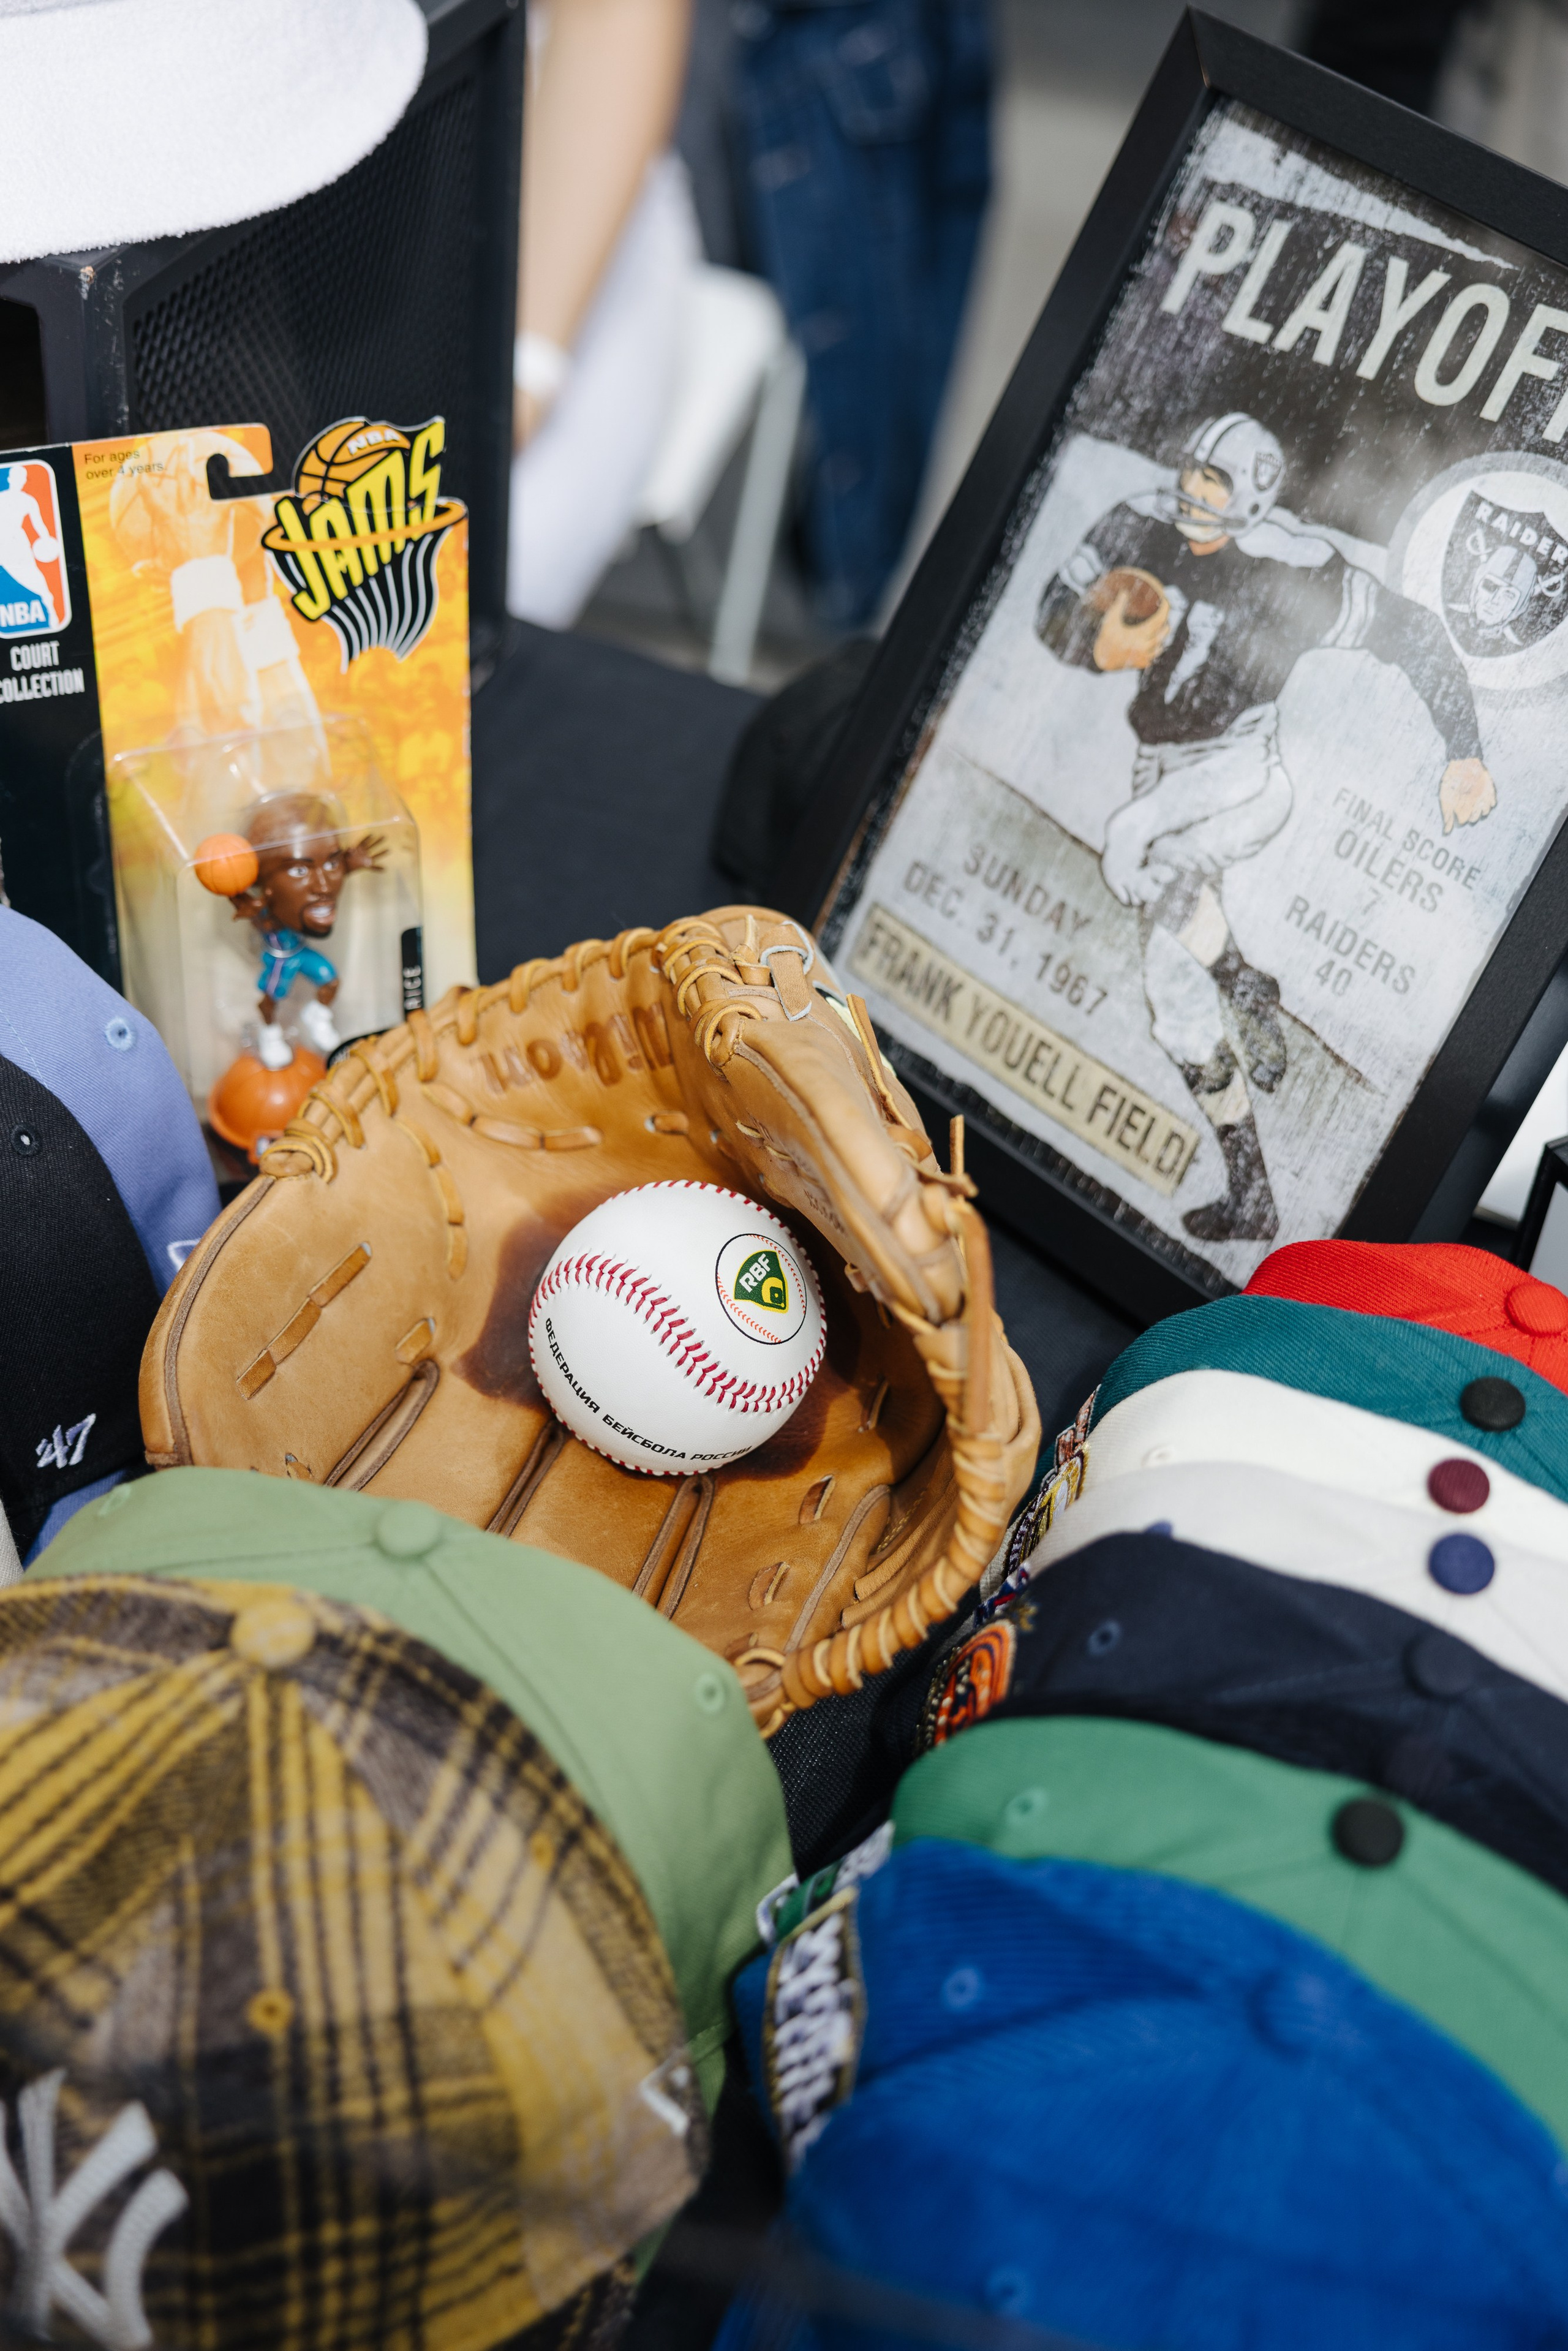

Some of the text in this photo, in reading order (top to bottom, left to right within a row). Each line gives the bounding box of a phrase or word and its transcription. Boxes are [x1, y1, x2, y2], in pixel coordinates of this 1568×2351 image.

[1161, 201, 1568, 443] PLAYOF
[85, 451, 140, 464] For ages
[86, 468, 113, 480] over
[347, 429, 399, 455] NBA
[277, 421, 445, 620] JAMS
[0, 599, 47, 627] NBA
[10, 640, 59, 671] COURT
[1332, 788, 1481, 890] FINAL SCORE
[1333, 828, 1444, 913] OILERS
[963, 843, 1093, 941] SUNDAY
[1361, 888, 1382, 916] 7
[903, 861, 1108, 1016] DEC. 31, 1967
[1285, 895, 1416, 995] RAIDERS
[403, 964, 423, 1011] RICE
[1314, 960, 1352, 997] 40
[859, 921, 1186, 1176] FRANK YOUELL FIELD
[738, 1253, 771, 1293] RBF
[545, 1318, 753, 1461] ФЕДЕРАЦИЯ БЕЙСБОЛА РОССИИ
